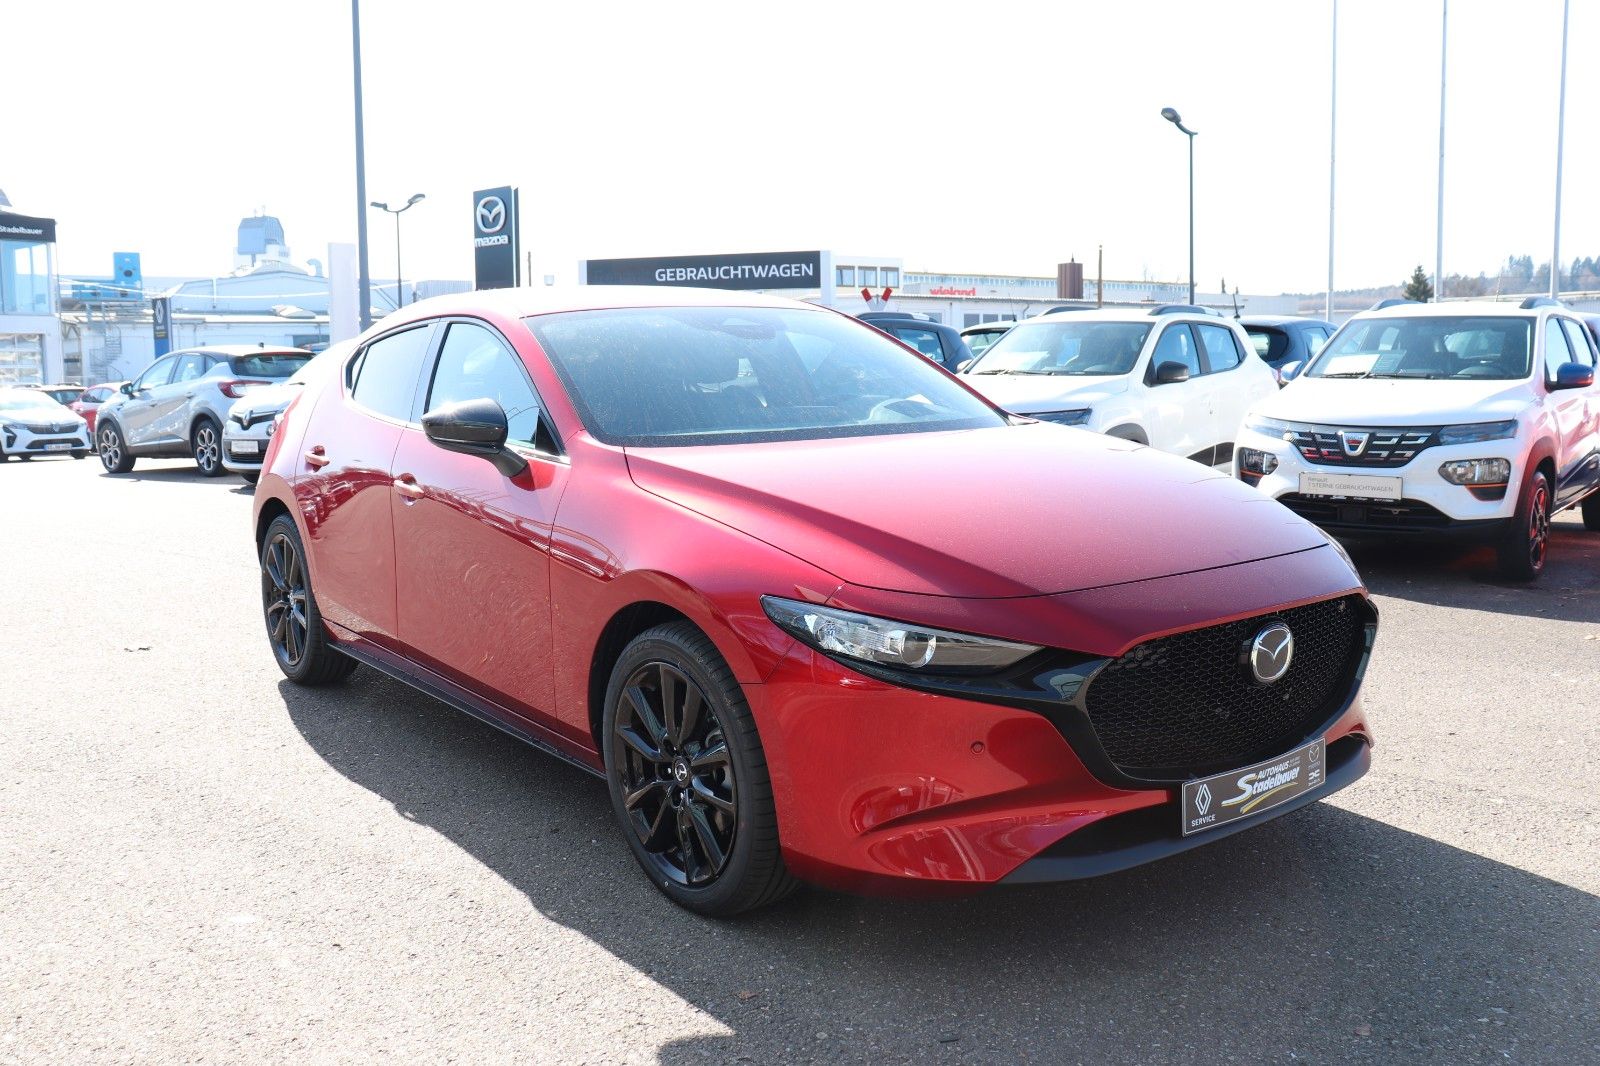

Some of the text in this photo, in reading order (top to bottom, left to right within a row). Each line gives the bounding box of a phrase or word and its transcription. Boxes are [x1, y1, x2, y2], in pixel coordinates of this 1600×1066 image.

[475, 235, 508, 247] mazda
[655, 263, 813, 282] GEBRAUCHTWAGEN
[1257, 761, 1290, 780] AUTOHAUS
[1221, 766, 1299, 806] Stadelbauer
[1191, 814, 1216, 827] SERVICE
